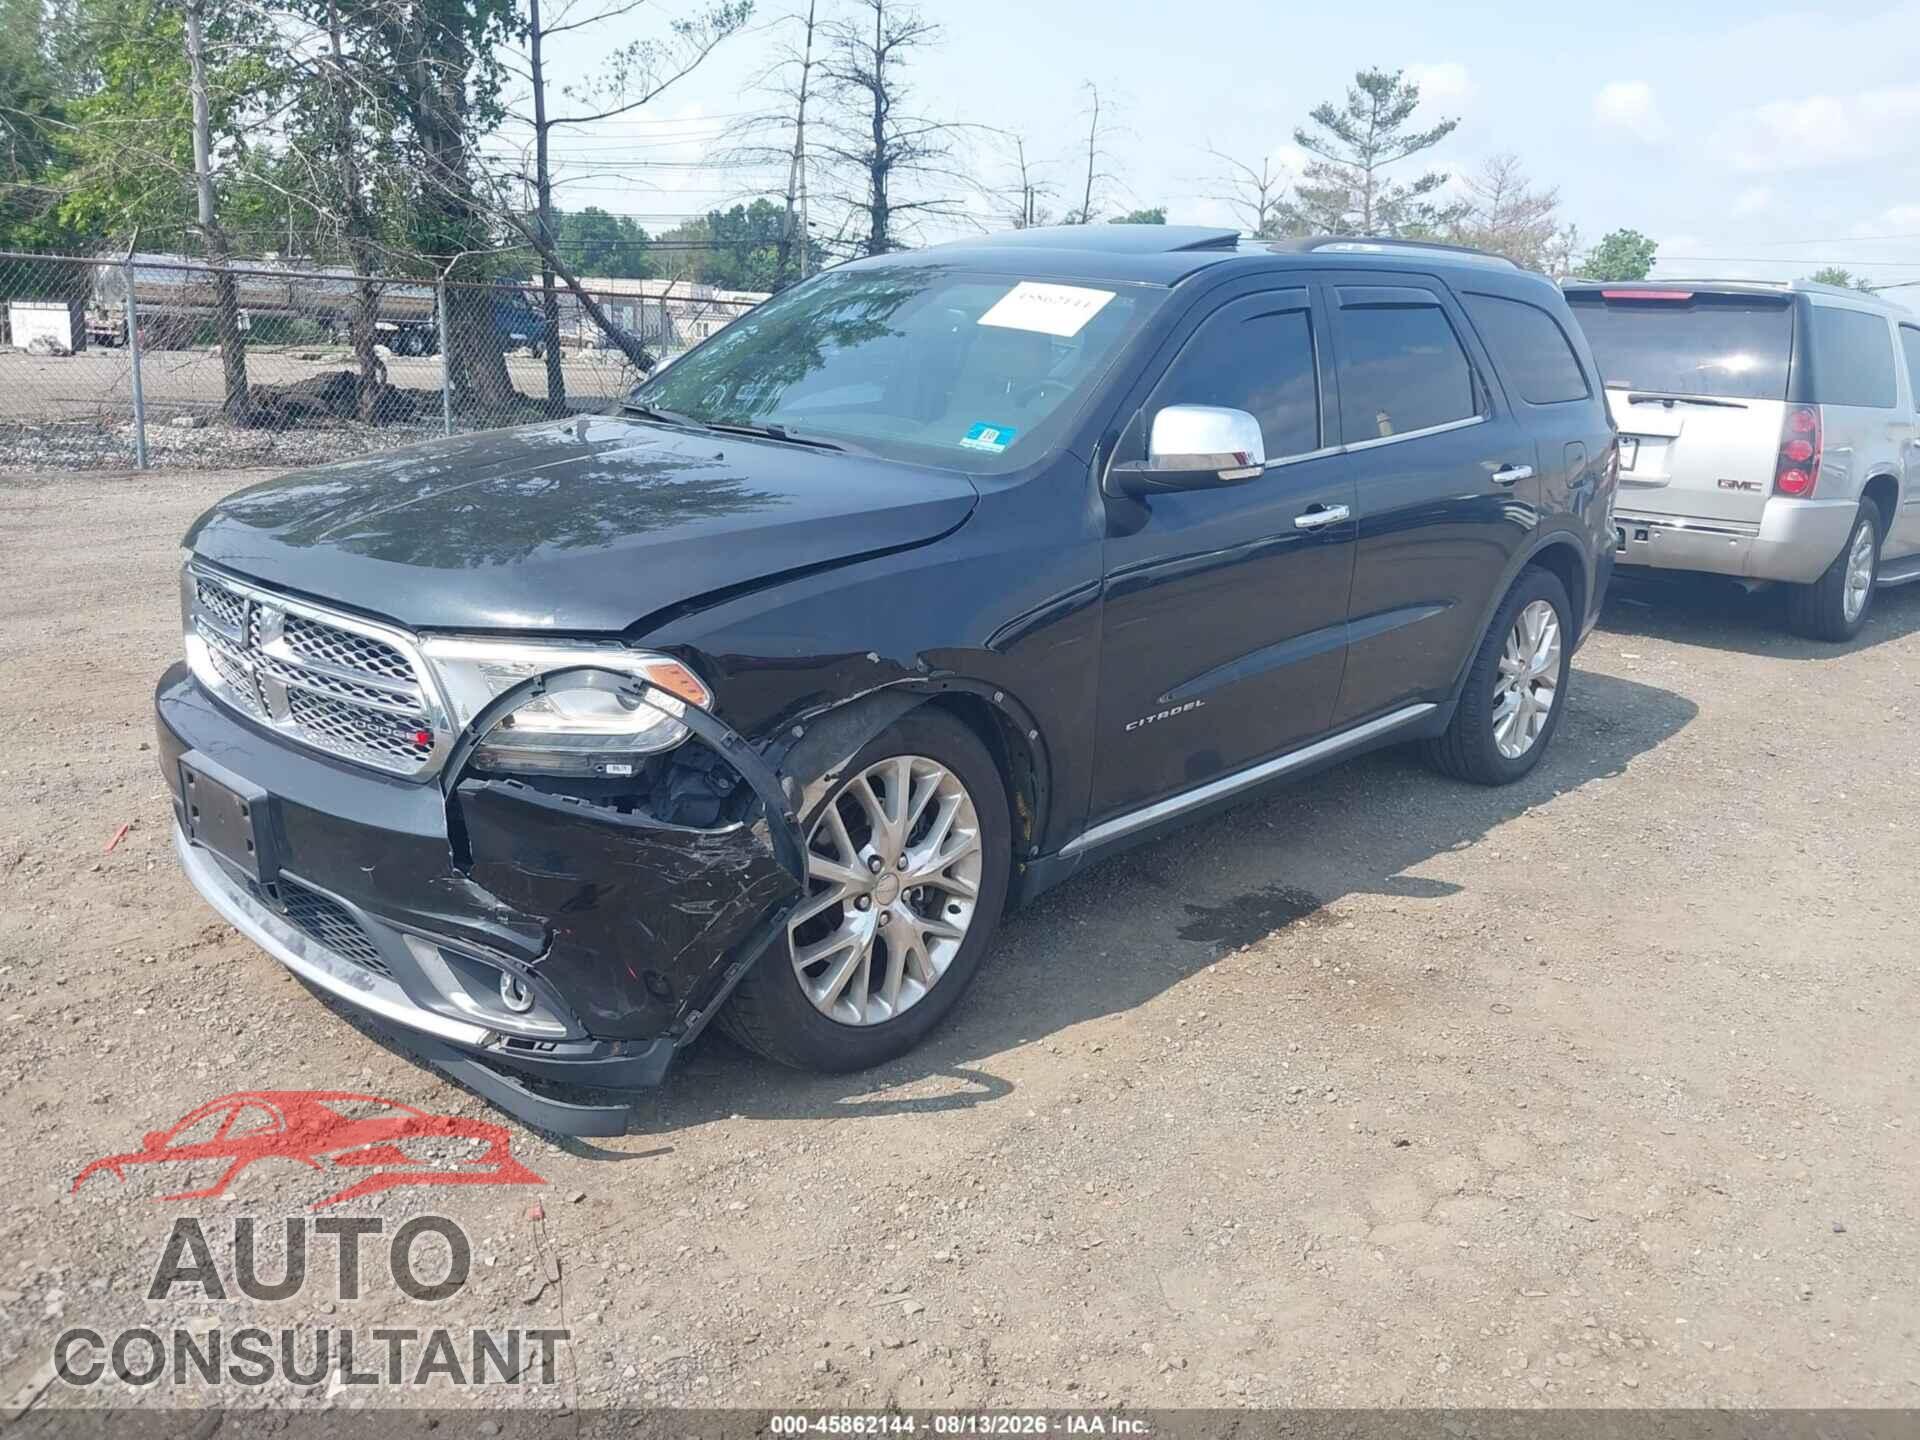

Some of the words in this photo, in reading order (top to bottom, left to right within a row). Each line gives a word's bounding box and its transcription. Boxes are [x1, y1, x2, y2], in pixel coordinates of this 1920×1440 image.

[1717, 478, 1764, 492] GMC
[1125, 699, 1206, 731] CITADEL
[354, 719, 418, 742] DODGE
